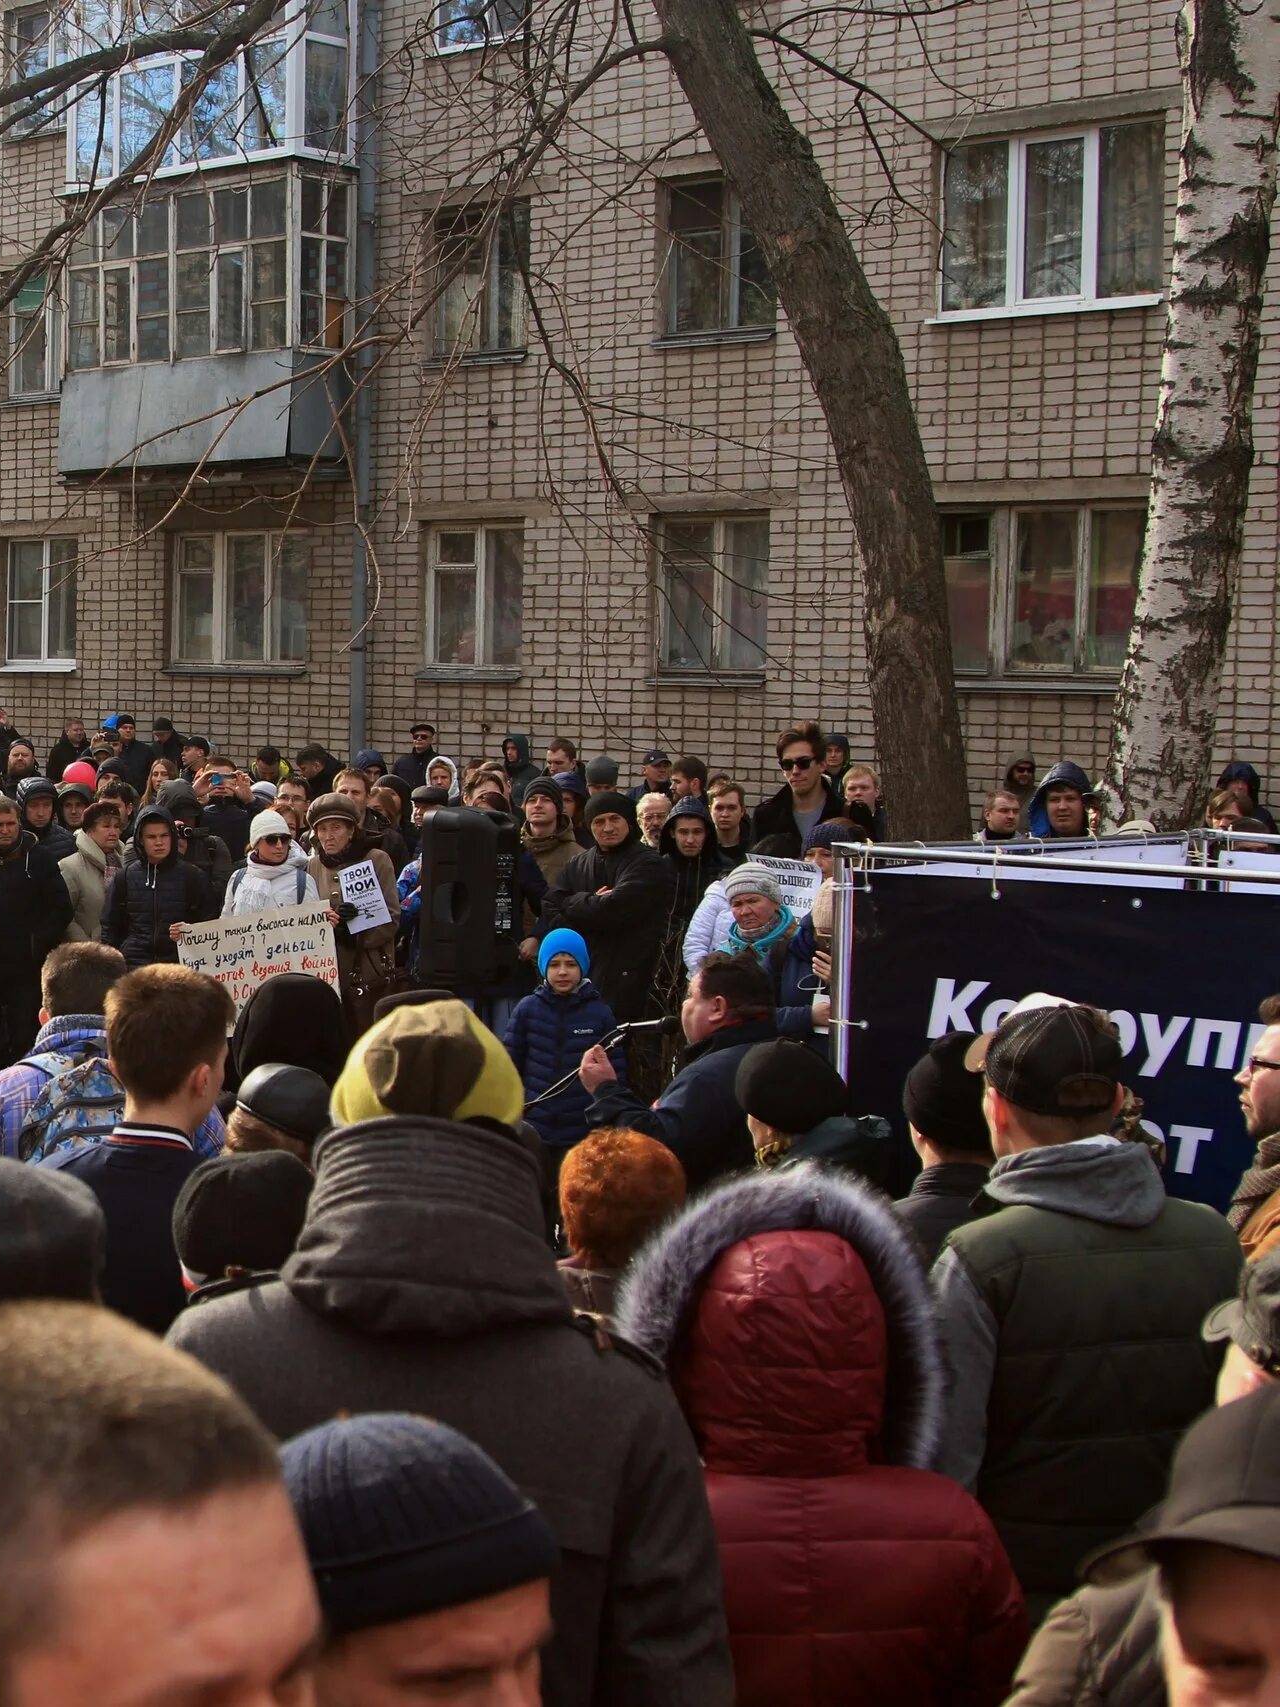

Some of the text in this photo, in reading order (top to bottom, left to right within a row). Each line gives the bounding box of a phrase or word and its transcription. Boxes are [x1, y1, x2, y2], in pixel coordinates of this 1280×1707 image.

[344, 865, 371, 882] ТВОИ
[345, 877, 376, 896] МОИ
[178, 929, 221, 951] Почему
[225, 924, 253, 938] такие
[256, 918, 295, 931] высокие
[215, 949, 255, 967] уходят
[266, 939, 316, 960] деньги
[251, 960, 292, 981] ведения
[301, 954, 335, 970] войны
